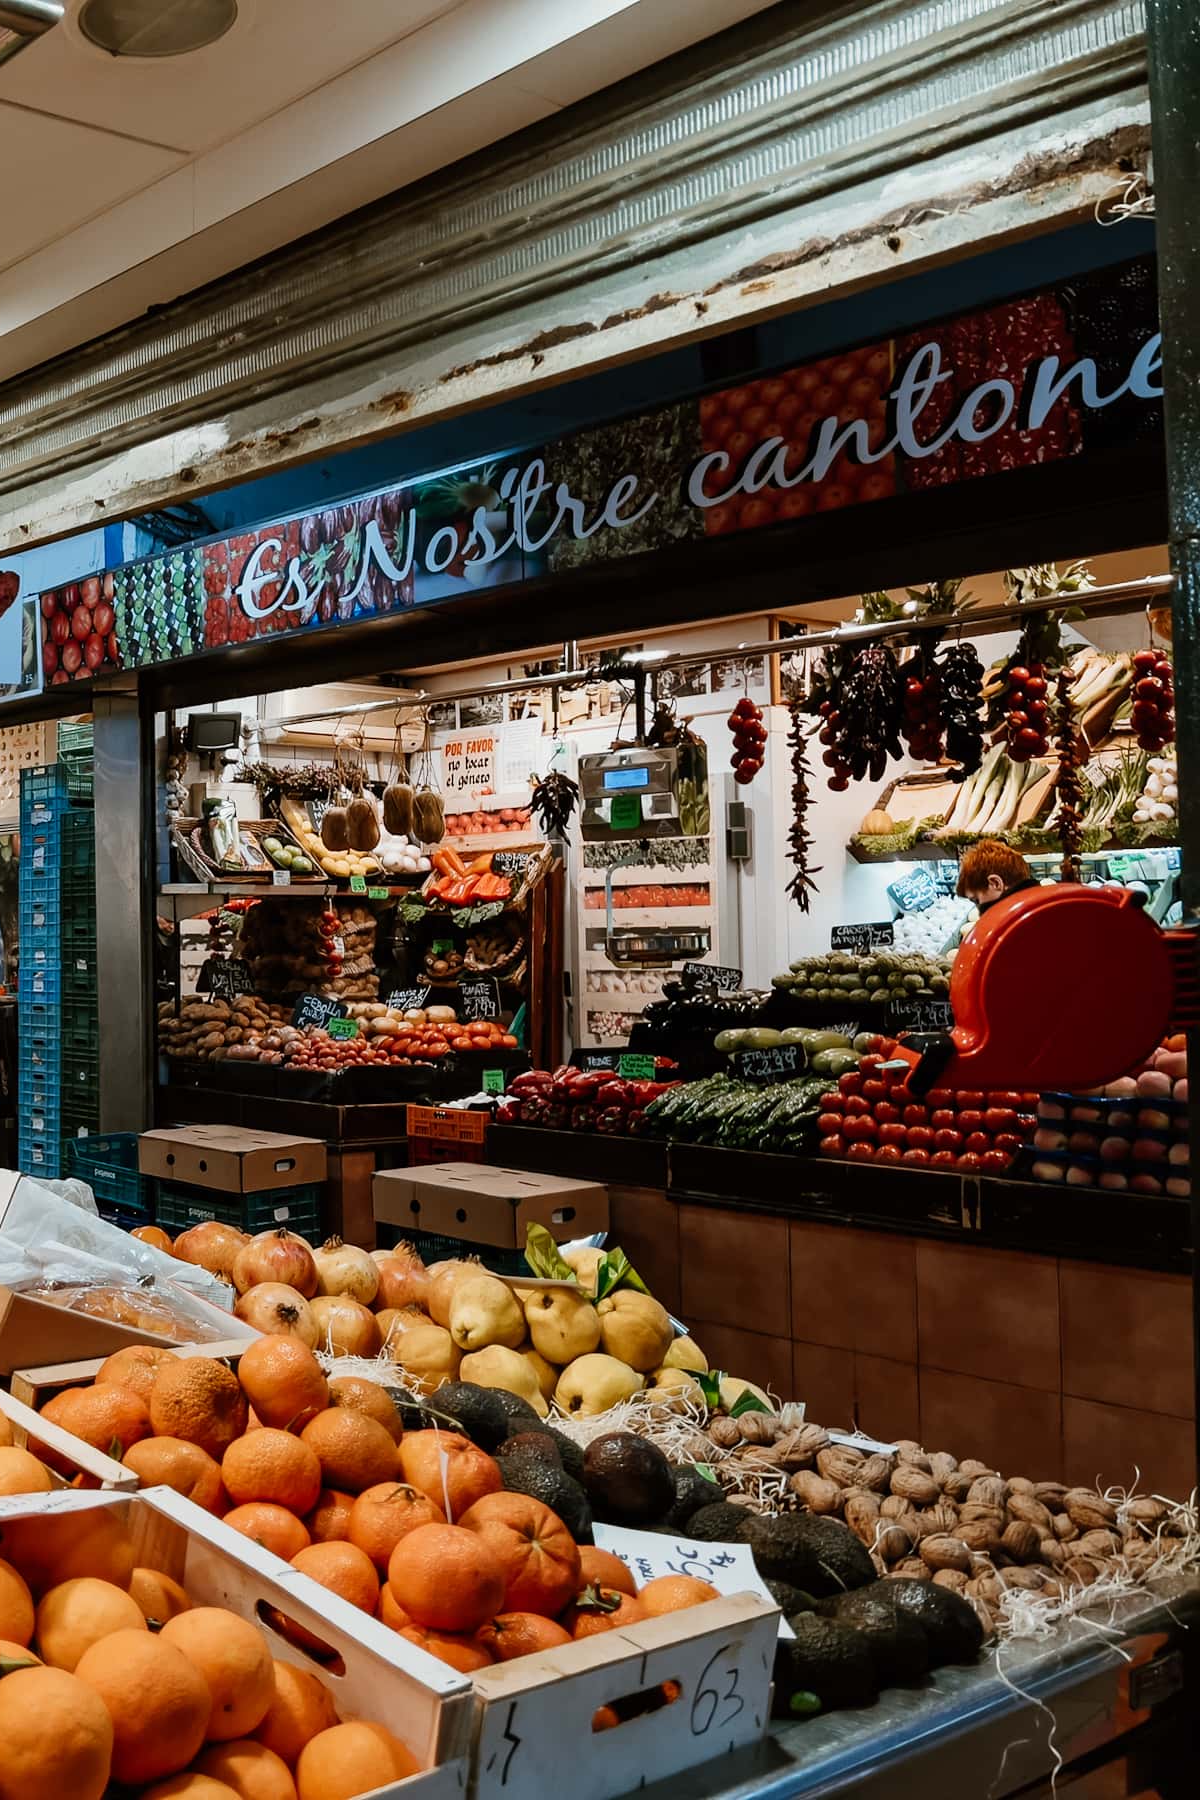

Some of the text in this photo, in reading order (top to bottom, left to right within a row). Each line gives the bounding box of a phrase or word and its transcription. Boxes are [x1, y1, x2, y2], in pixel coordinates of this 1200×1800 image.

[235, 537, 325, 620] Es
[340, 457, 660, 604] Nostre
[444, 738, 494, 757] POR FAVOR
[448, 756, 489, 772] no tocar
[446, 773, 455, 787] el
[689, 1643, 745, 1737] 63
